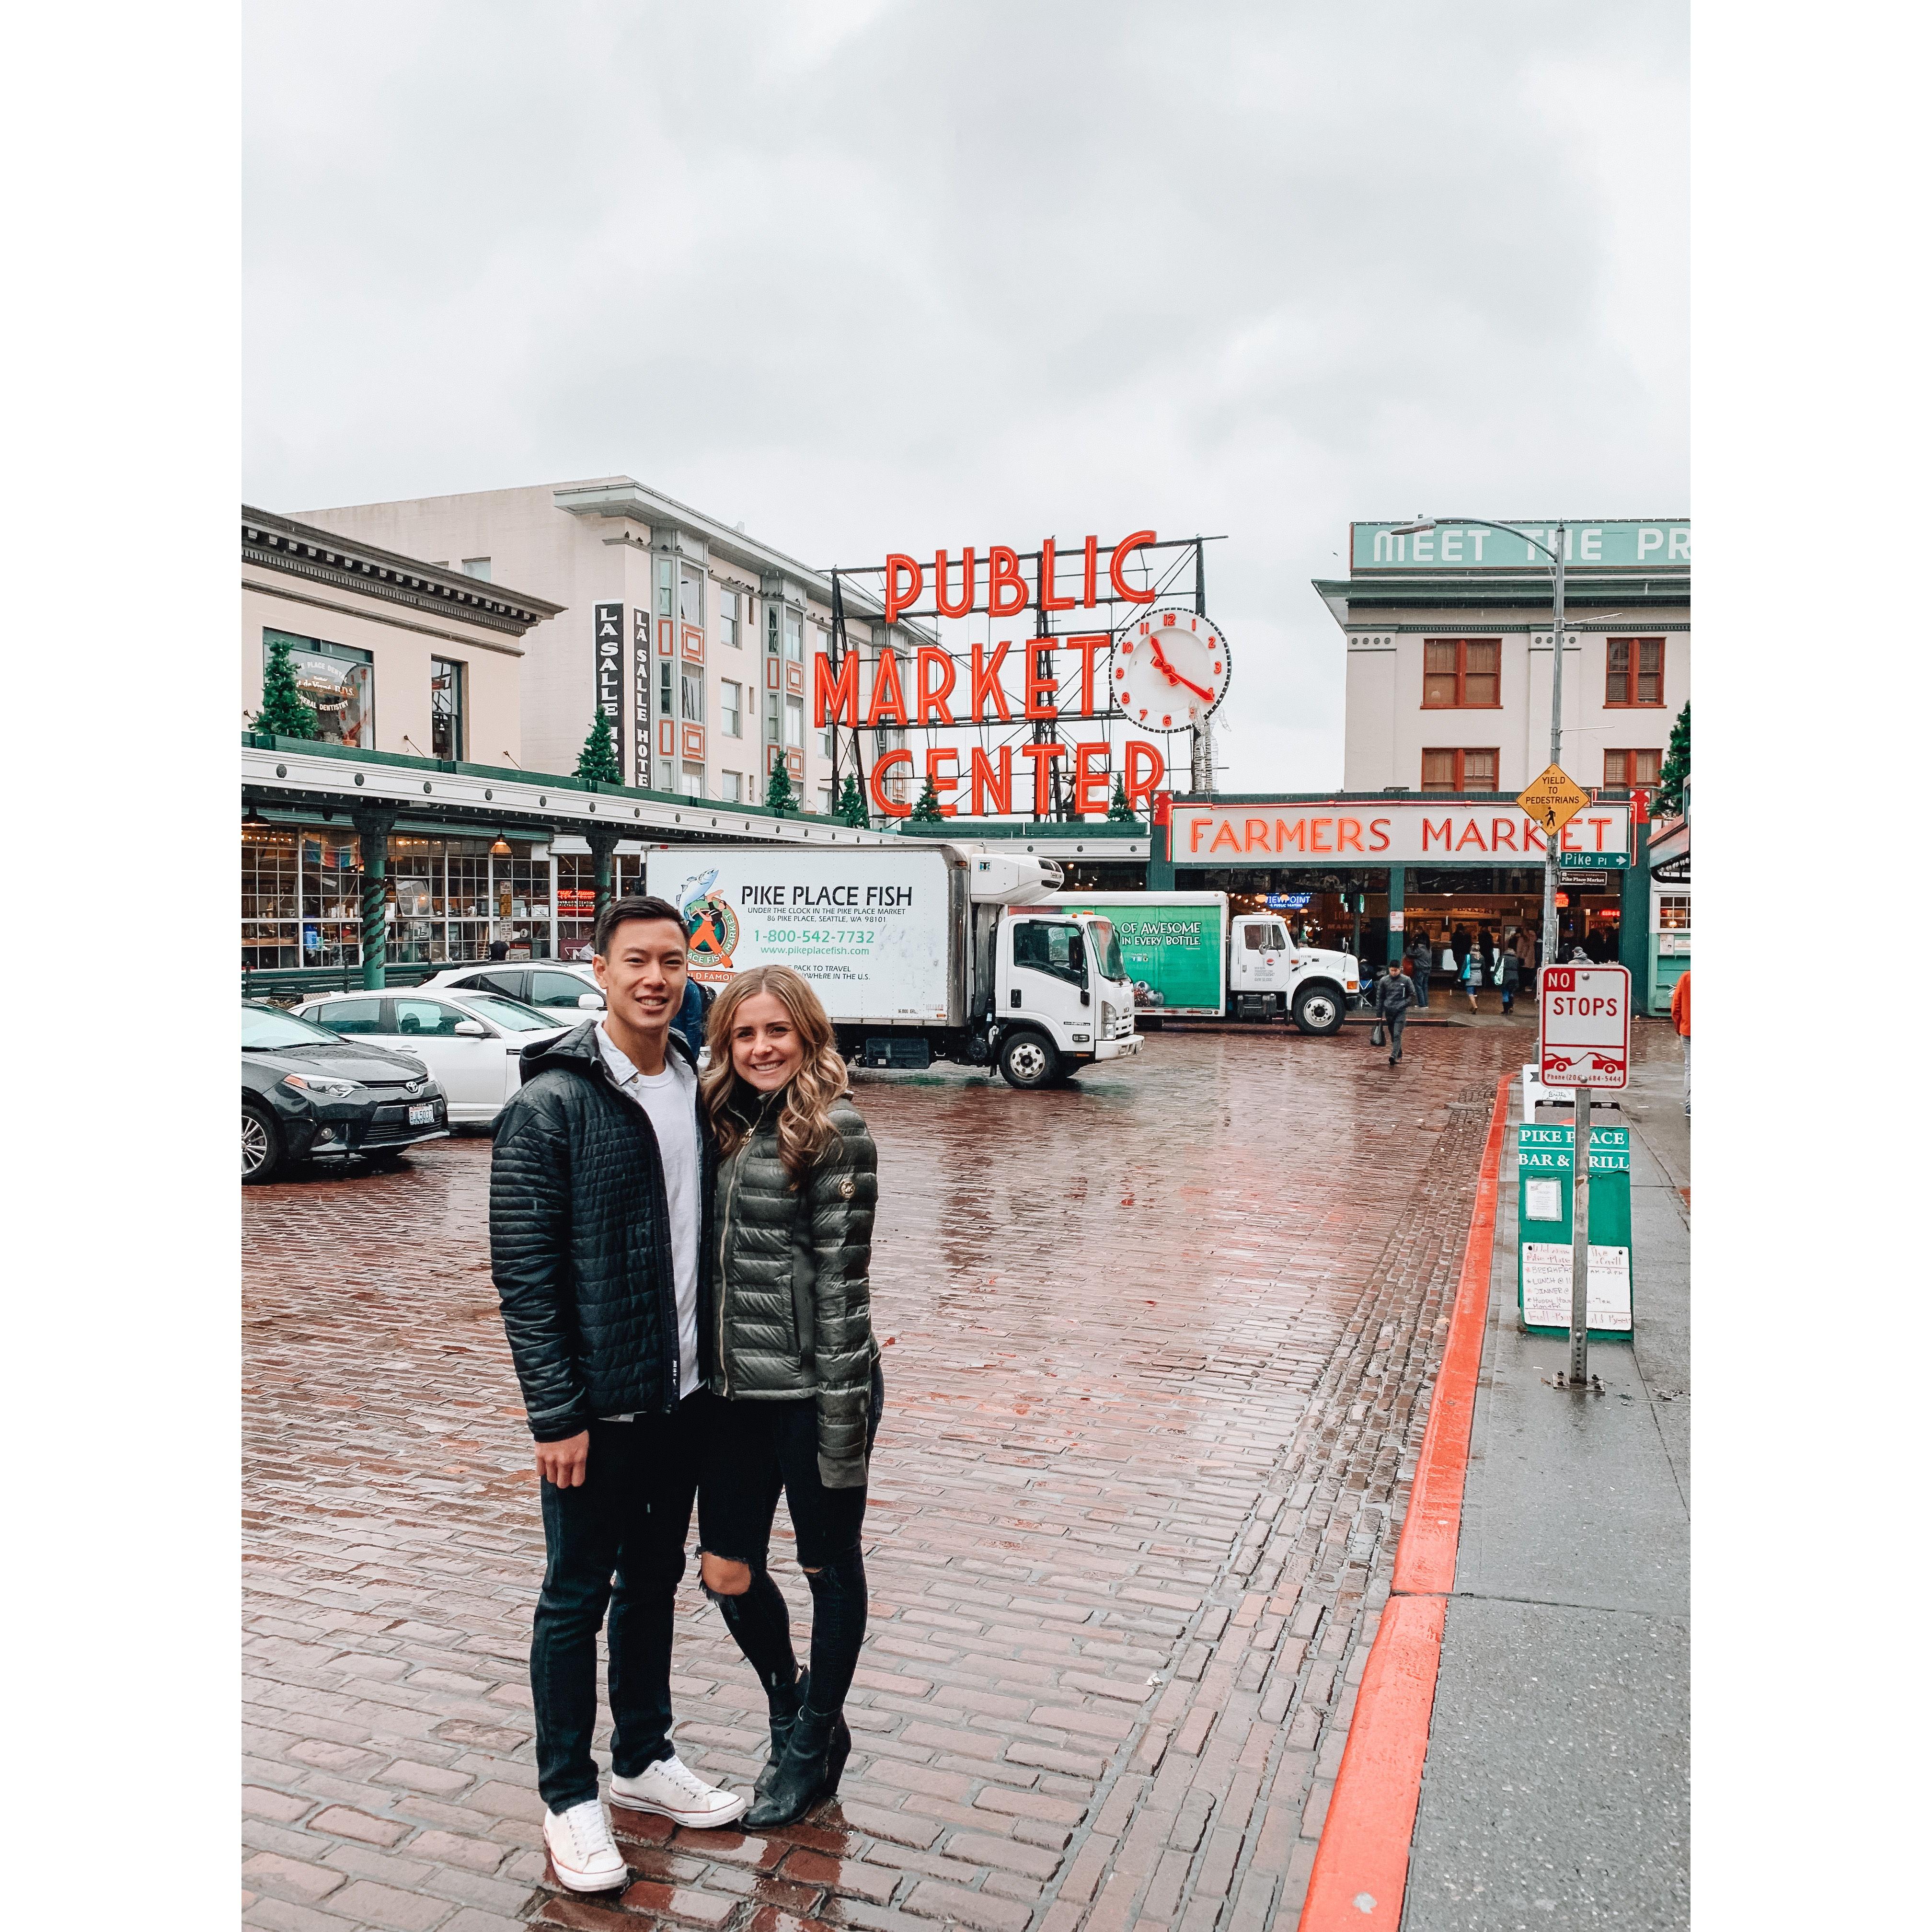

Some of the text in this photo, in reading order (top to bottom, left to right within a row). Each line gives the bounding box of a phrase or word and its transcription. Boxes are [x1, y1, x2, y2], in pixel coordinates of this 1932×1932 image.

[1374, 528, 1690, 562] MEET THE PR
[886, 530, 1157, 623] PUBLIC
[599, 608, 619, 636] LA
[636, 611, 647, 642] LA
[1163, 614, 1176, 626] 12
[1192, 619, 1196, 632] 1
[1140, 622, 1149, 635] 11
[1122, 642, 1133, 654] 10
[1208, 636, 1216, 648] 2
[1116, 668, 1124, 679] 9
[1214, 662, 1221, 674] 3
[599, 642, 619, 716] SALLE
[815, 634, 1111, 728] MARKET
[636, 650, 648, 722] SALLE
[1122, 692, 1130, 703] 8
[320, 700, 348, 711] DENTISTRY
[1139, 710, 1148, 721] 7
[1163, 715, 1171, 726] 6
[871, 741, 1165, 817] CENTER
[1526, 796, 1579, 804] PEDESTRIANS
[1191, 818, 1612, 852] FARMERS MARKET
[1565, 853, 1591, 865] Pike
[742, 886, 912, 906] PIKE PLACE FISH
[1121, 921, 1201, 935] OF AWESOME
[707, 950, 725, 964] FISH
[725, 913, 735, 951] MARKET
[755, 930, 874, 943] 1-800-542-7732
[1122, 936, 1201, 945] IN EVERY BOTTLE.
[761, 946, 869, 956] www.pikeplacefish.com
[1548, 972, 1570, 988] NO
[1553, 997, 1618, 1016] STOPS
[1520, 1130, 1625, 1144] PIKE PACE
[1518, 1153, 1629, 1169] BAR & RILL
